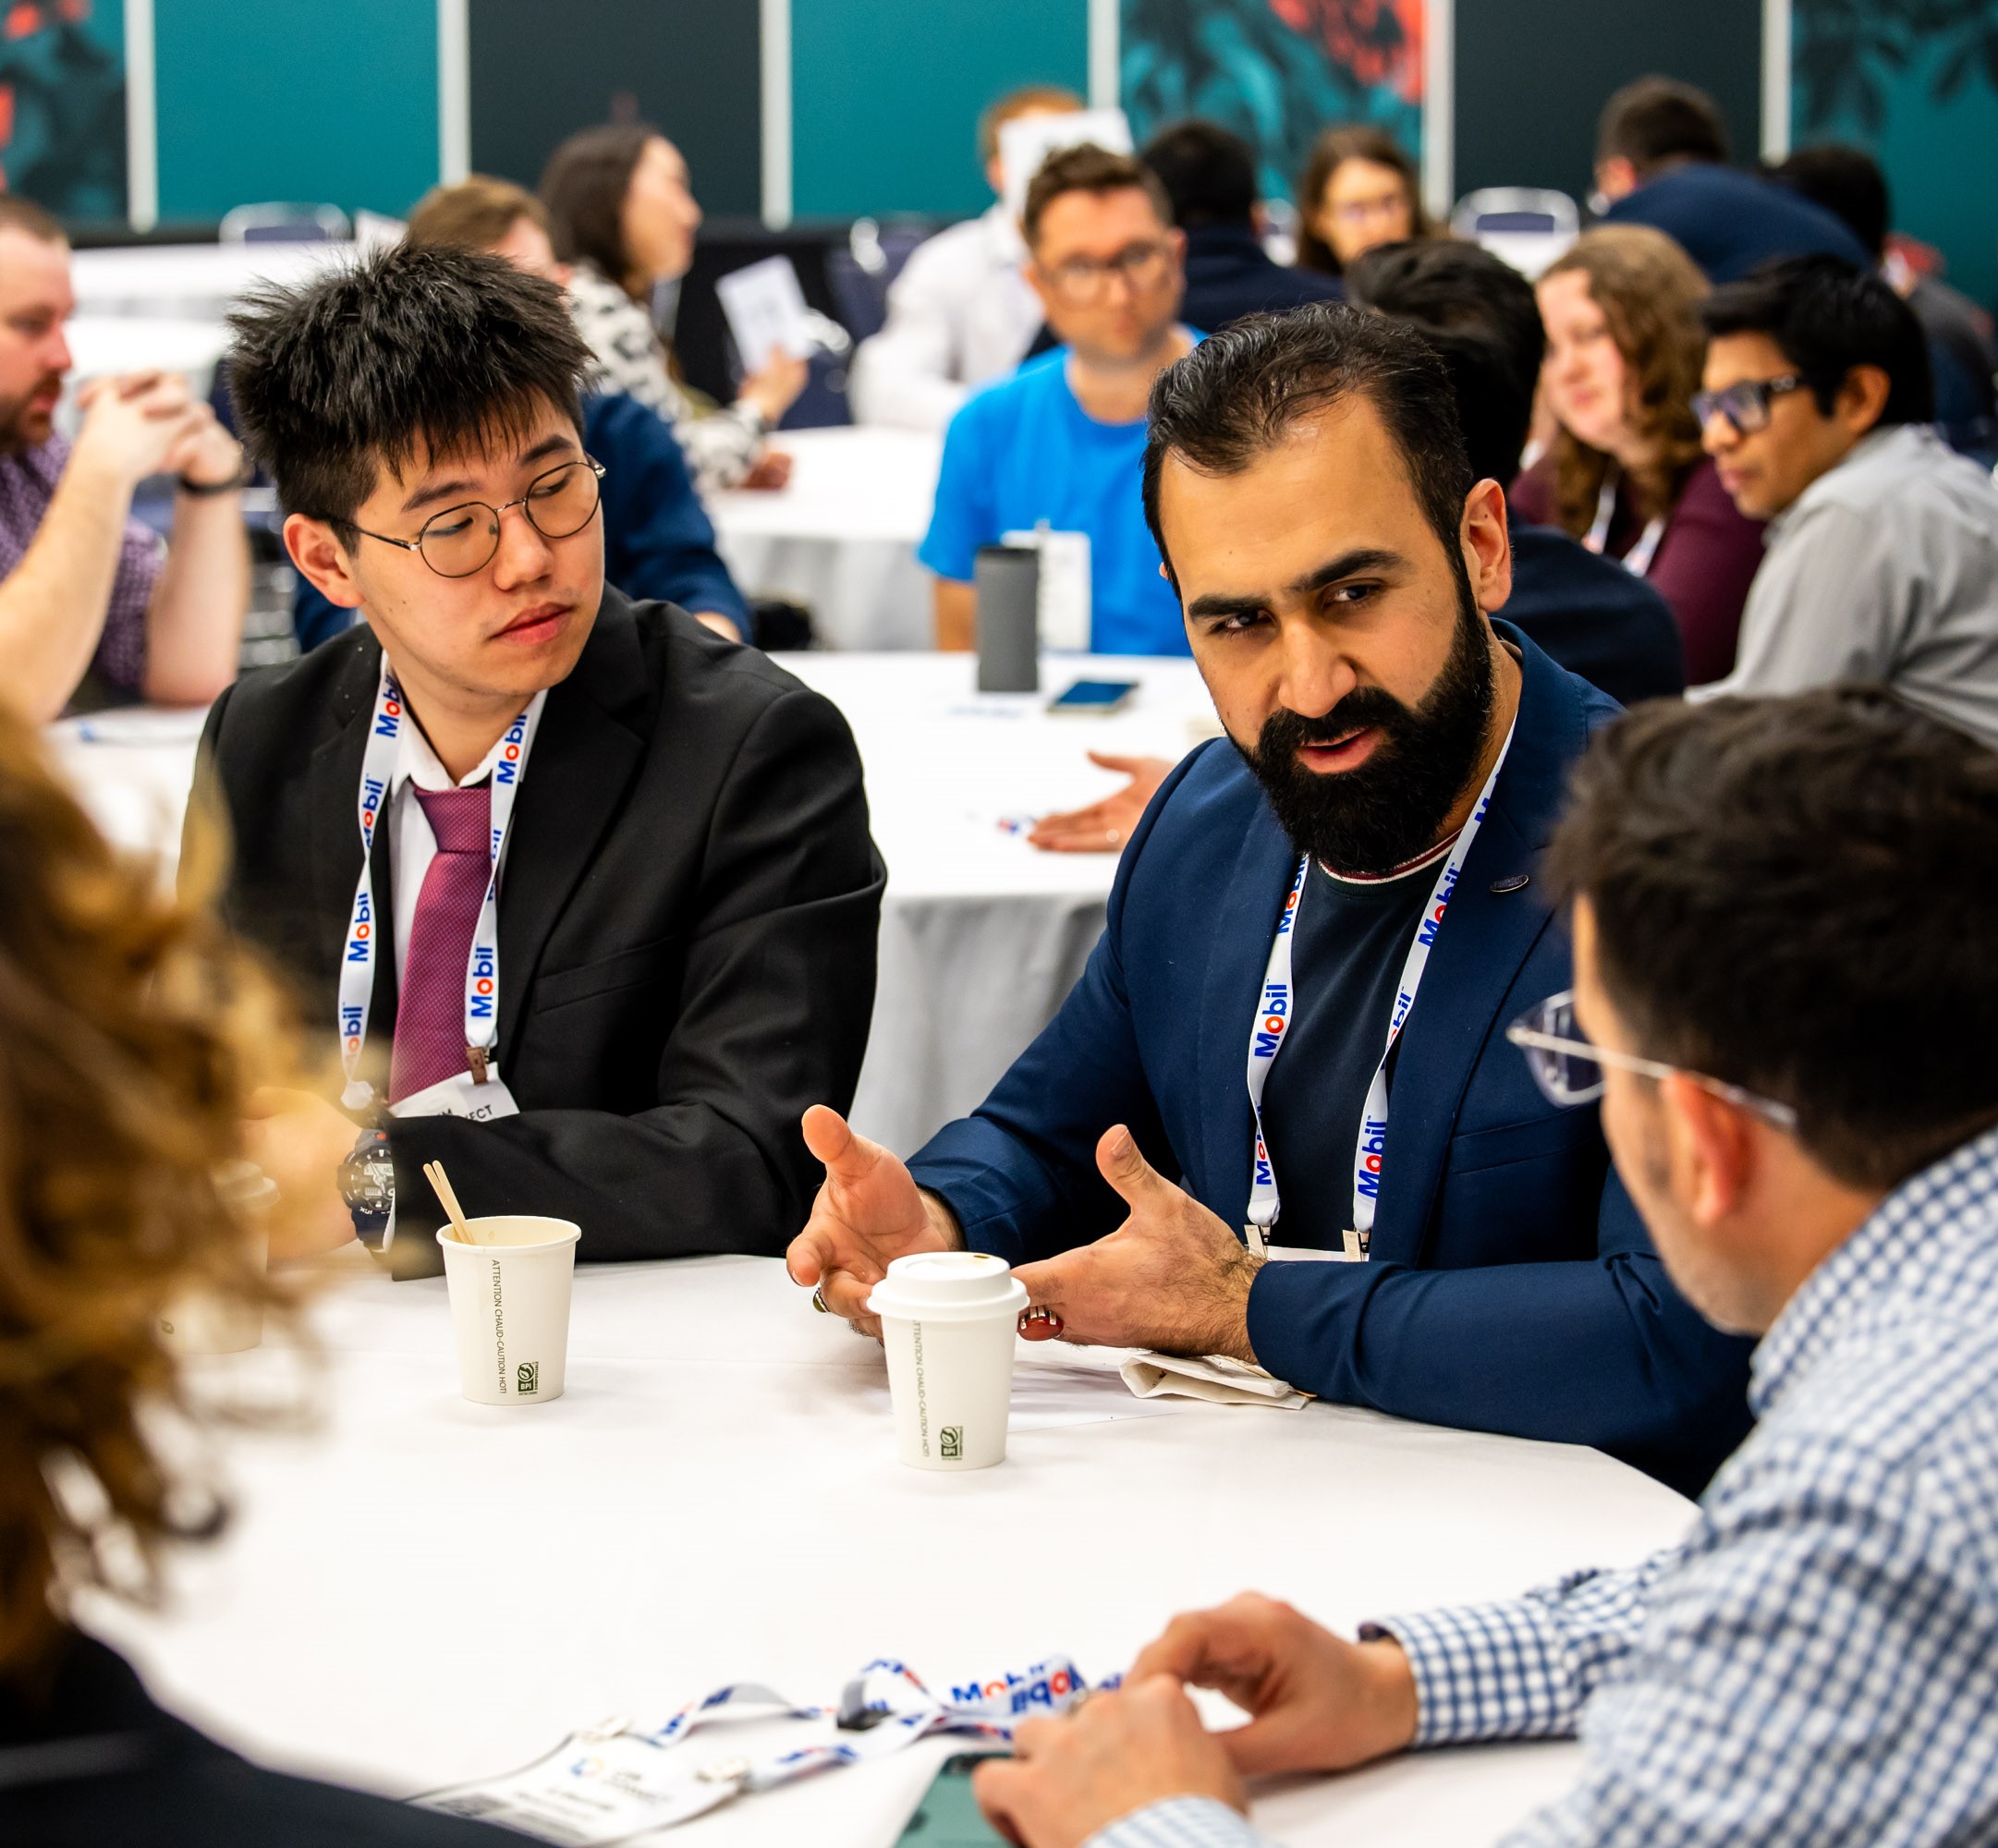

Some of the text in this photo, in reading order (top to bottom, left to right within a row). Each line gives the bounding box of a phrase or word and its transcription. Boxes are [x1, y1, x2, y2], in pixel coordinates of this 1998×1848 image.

[496, 714, 528, 784] Mobil
[347, 893, 371, 963] Mobil
[1418, 869, 1459, 947] Mobil
[471, 946, 493, 1018] Mobil
[343, 1006, 363, 1054] obil
[1254, 984, 1288, 1058] Mobil
[1358, 1121, 1387, 1198] Mobil
[492, 1259, 502, 1307] ATTENTION
[913, 1321, 922, 1366] TTENTION
[520, 1382, 532, 1391] BPI
